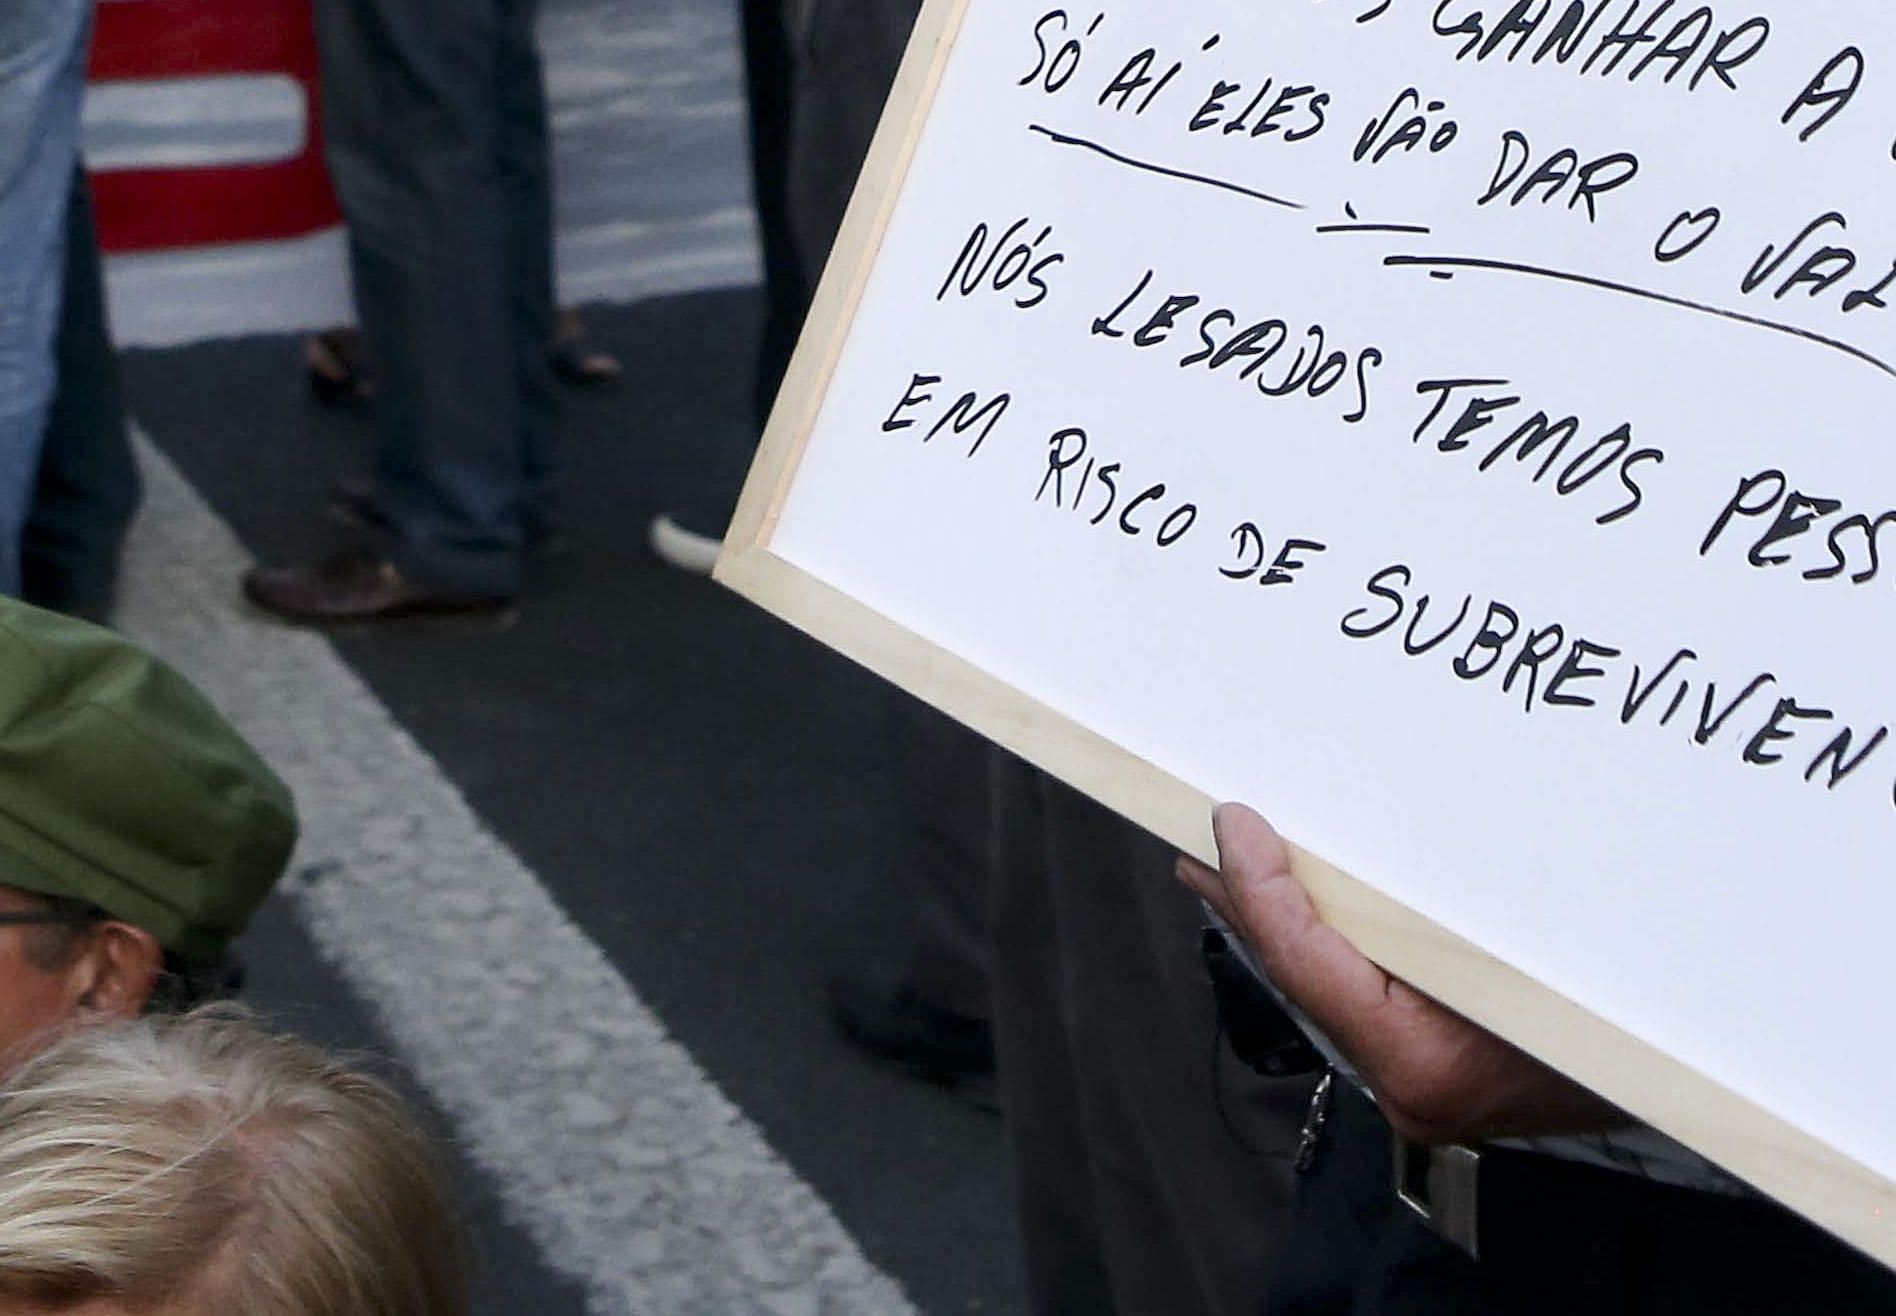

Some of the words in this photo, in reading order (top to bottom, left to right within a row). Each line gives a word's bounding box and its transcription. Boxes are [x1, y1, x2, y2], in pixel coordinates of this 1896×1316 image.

[1017, 8, 1106, 95] SÓ
[1187, 76, 1331, 143] ELES
[1352, 86, 1459, 165] VÃO
[1476, 129, 1640, 224] DAR
[1653, 205, 1722, 264] O
[1780, 45, 1866, 144] A
[880, 372, 1011, 459] EM
[1034, 426, 1198, 548] RISCO
[1217, 521, 1328, 587] DE
[935, 216, 1065, 310] NÓS
[1090, 268, 1384, 425] LESADOS
[1411, 377, 1665, 526] TEMOS
